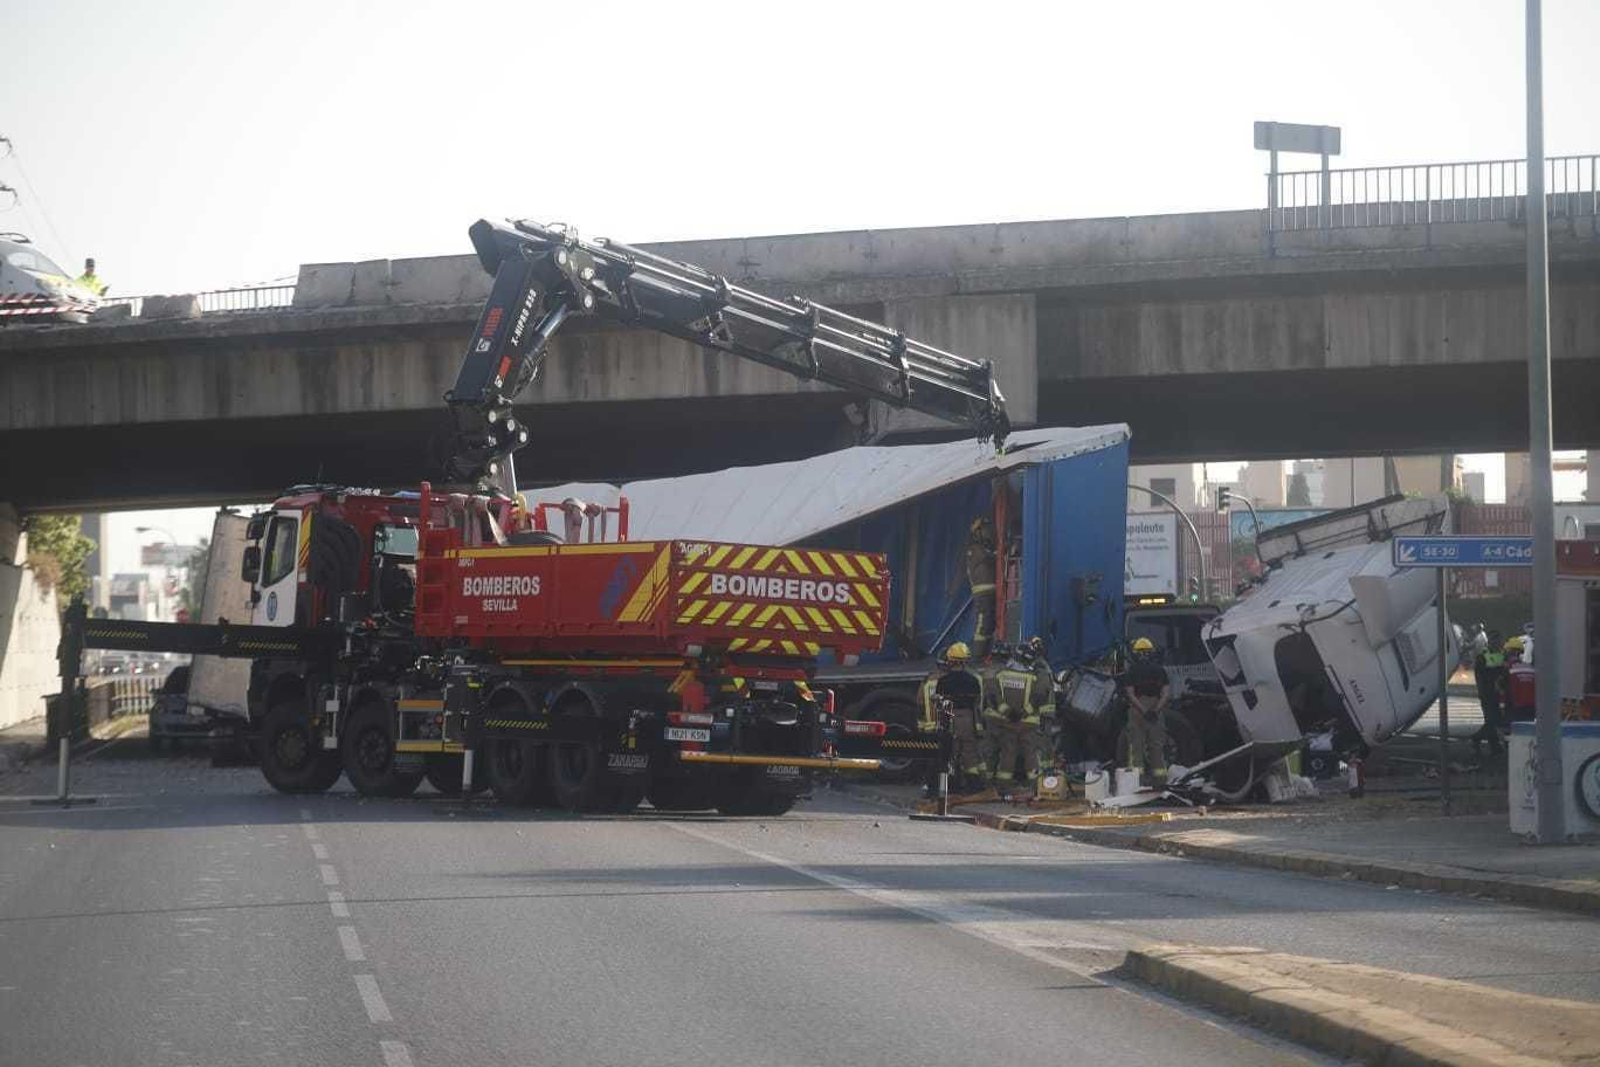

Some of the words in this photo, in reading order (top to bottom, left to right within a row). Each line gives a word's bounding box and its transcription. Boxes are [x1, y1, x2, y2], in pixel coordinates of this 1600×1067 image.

[463, 576, 541, 596] BOMBEROS
[711, 573, 851, 604] BOMBEROS
[482, 598, 518, 611] SEVILLA
